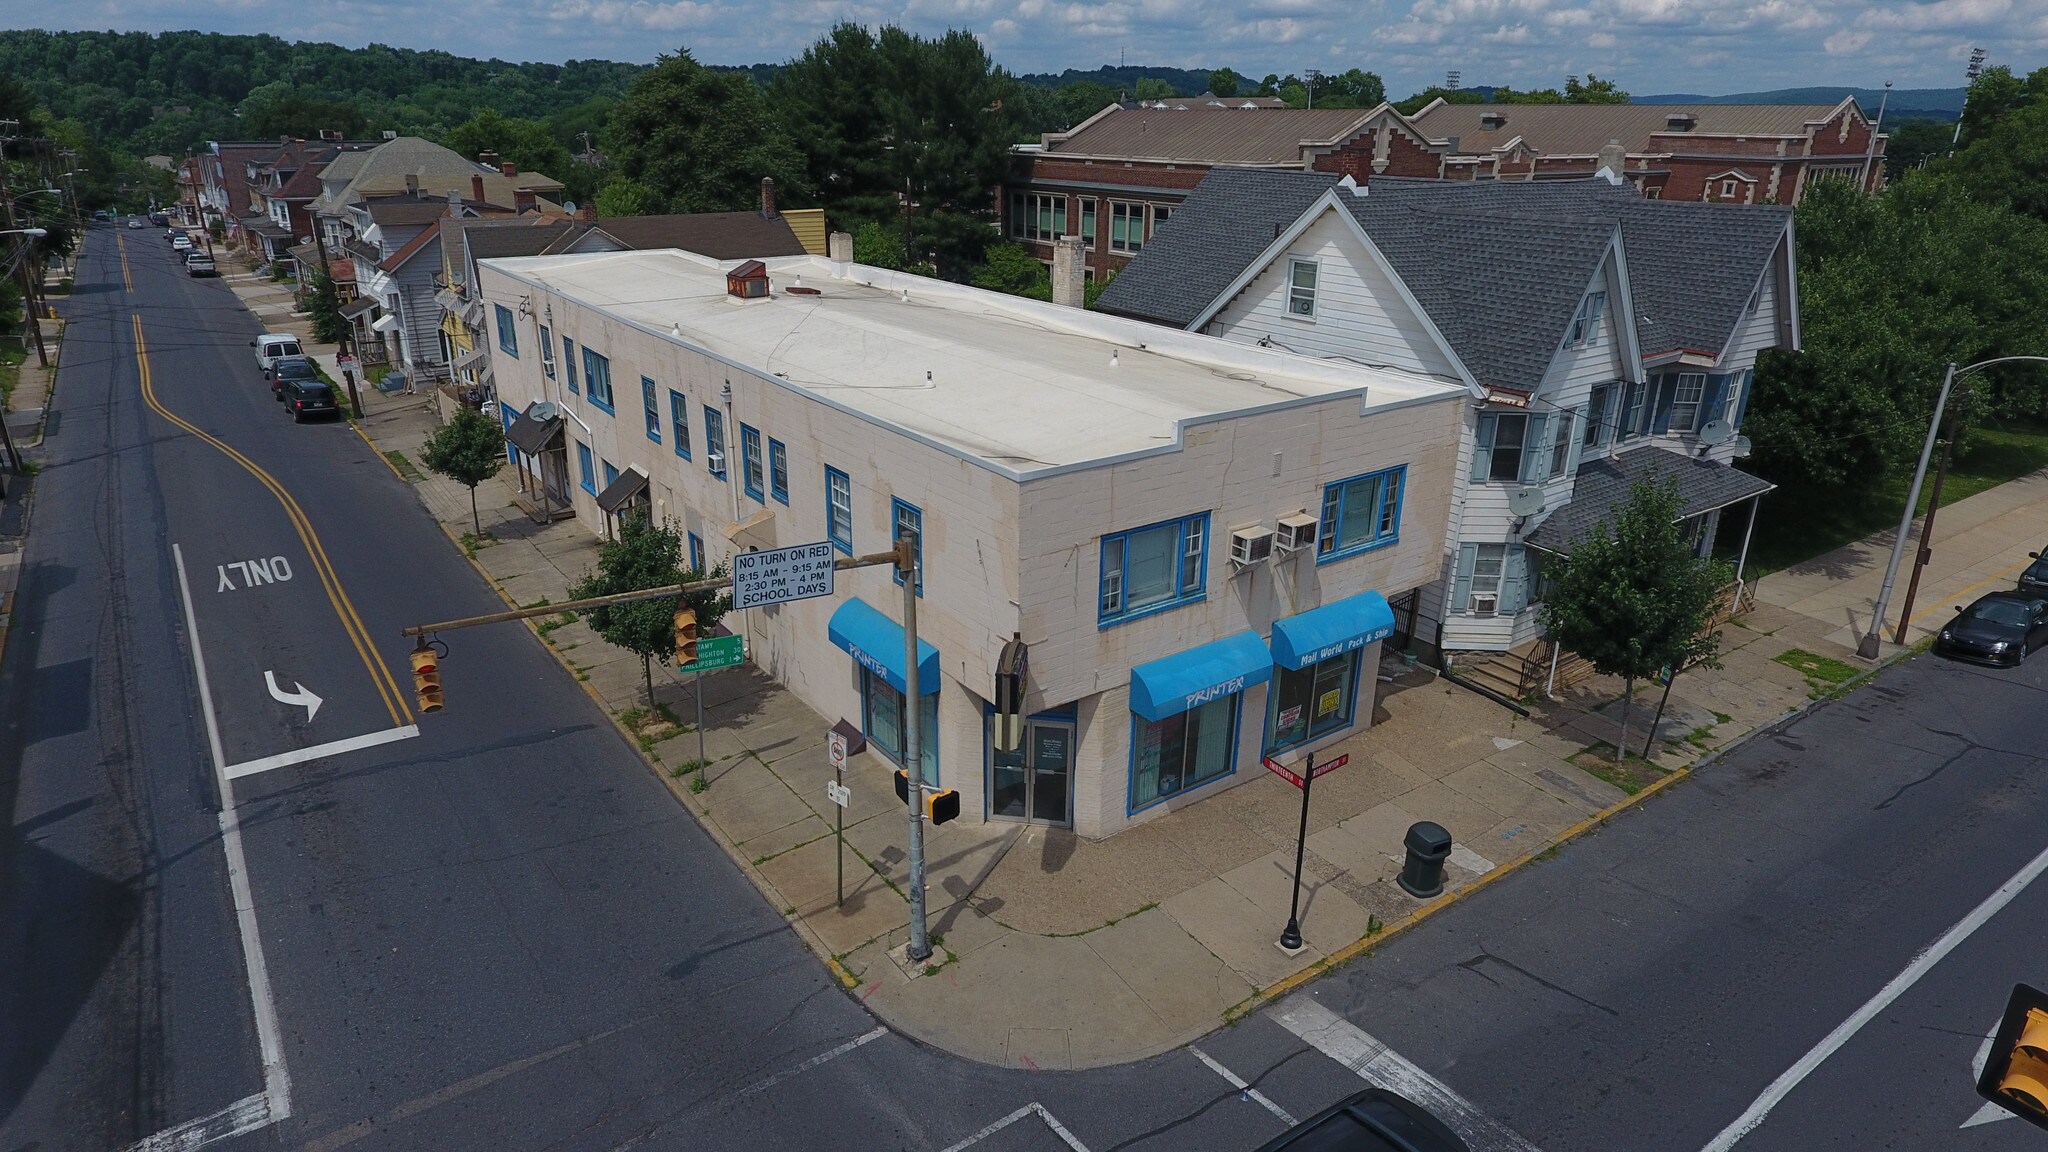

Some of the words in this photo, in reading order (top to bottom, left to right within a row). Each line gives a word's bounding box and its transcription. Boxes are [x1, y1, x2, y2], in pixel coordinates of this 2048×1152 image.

[740, 558, 754, 568] NO
[759, 552, 786, 565] TURN
[790, 549, 805, 561] ON
[810, 546, 829, 558] RED
[218, 556, 292, 592] ONLY
[739, 572, 758, 582] 8:15
[763, 568, 778, 578] AM
[792, 563, 811, 573] 9:15
[816, 561, 830, 570] AM
[745, 581, 767, 591] 2:30
[772, 578, 786, 587] PM
[811, 572, 824, 580] PM
[743, 588, 792, 605] SCHOOL
[798, 582, 826, 595] DAYS
[699, 650, 724, 658] HIGHTON
[1301, 652, 1317, 666] Mail
[1321, 643, 1343, 658] World
[1348, 637, 1364, 649] Pack
[1366, 634, 1372, 642] &
[1375, 629, 1388, 639] Ship
